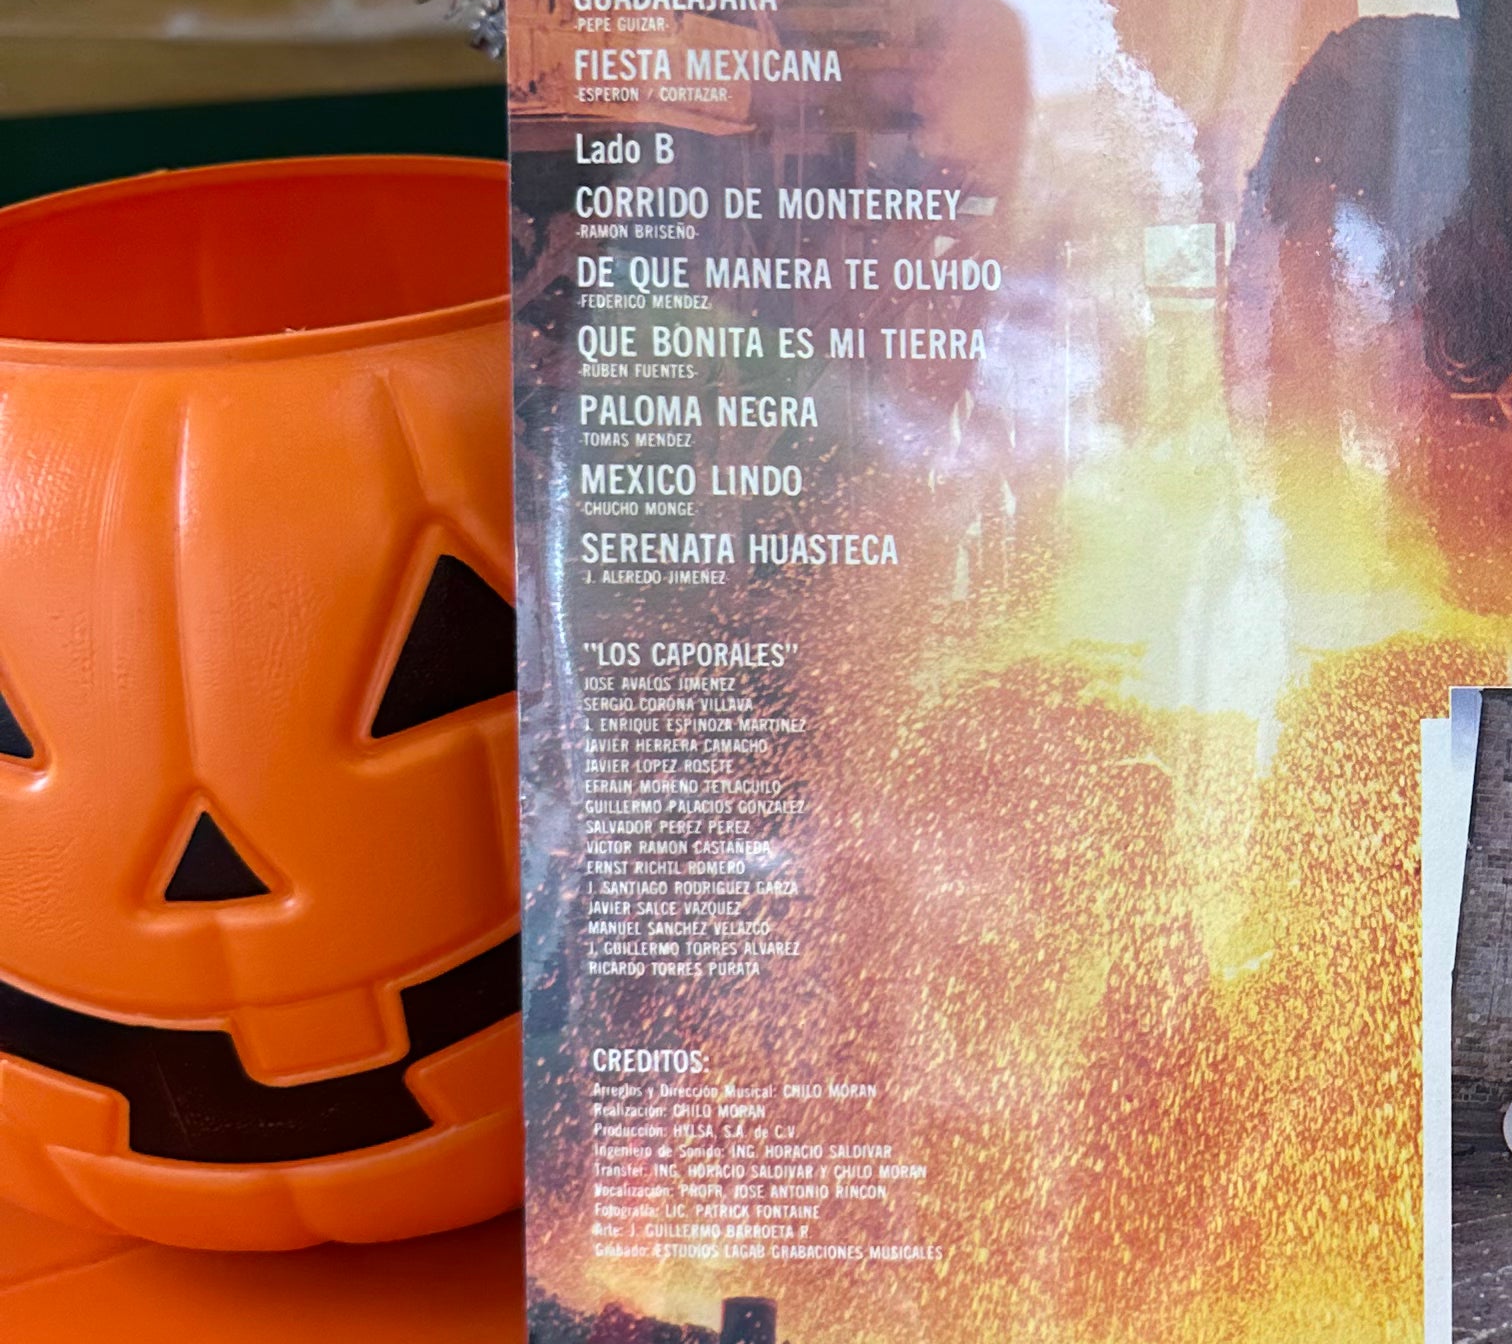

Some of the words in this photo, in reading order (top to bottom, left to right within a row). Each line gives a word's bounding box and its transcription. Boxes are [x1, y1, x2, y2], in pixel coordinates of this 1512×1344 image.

[575, 49, 670, 81] FIESTA
[687, 49, 841, 81] MEXICANA
[577, 134, 640, 164] Lado
[656, 134, 674, 164] B
[577, 187, 708, 218] CORRIDO
[726, 188, 762, 219] DE
[779, 188, 960, 221] MONTERREY
[578, 257, 614, 288] DE
[630, 257, 688, 294] QUE
[707, 258, 831, 289] MANERA
[845, 259, 879, 290] TE
[895, 259, 1000, 291] OLVIDO
[578, 326, 636, 363] QUE
[654, 327, 763, 358] BONITA
[780, 328, 814, 359] ES
[830, 328, 864, 359] MI
[882, 329, 986, 360] TIERRA
[581, 395, 701, 427] PALOMA
[718, 396, 817, 428] NEGRA
[582, 464, 696, 496] MEXICO
[713, 465, 801, 496] LINDO
[582, 533, 734, 565] SERENATA
[750, 534, 897, 566] HUASTECA
[603, 570, 662, 584] ALFREDO
[584, 677, 614, 691] JOSE
[622, 677, 671, 691] AVALOS
[679, 677, 735, 691] JIMENEZ
[584, 698, 633, 712] SERGIO
[639, 698, 694, 712] CORONA
[600, 719, 659, 734] ENRIQUE
[667, 719, 732, 732] ESPINOZA
[739, 719, 806, 733] MARTINEZ
[585, 739, 629, 752] JAVIER
[636, 739, 697, 752] HERRERA
[704, 739, 767, 753] CAMACHO
[585, 759, 629, 773] JAVIER
[636, 759, 677, 773] LOPEZ
[685, 759, 734, 773] ROSETE
[586, 780, 632, 794] EFRAIN
[640, 780, 698, 794] MORENO
[585, 800, 662, 814] GUILLERMO
[670, 800, 732, 814] PALACIOS
[738, 800, 805, 815] GONZALEZ
[586, 820, 652, 834] SALVADOR
[660, 820, 701, 834] PEREZ
[709, 820, 750, 834] PEREZ
[587, 841, 632, 854] VICTOR
[639, 841, 687, 854] RAMON
[694, 838, 771, 855] CASTAÑEDA
[587, 861, 627, 875] ERNST
[688, 861, 745, 874] ROMERO
[603, 881, 667, 895] SANTIAGO
[675, 881, 749, 895] RODRIGUEZ
[756, 881, 798, 895] GARZA
[588, 902, 630, 915] JAVIER
[637, 902, 676, 915] SALCE
[684, 902, 741, 916] VAZQUEZ
[588, 922, 641, 935] MANUEL
[648, 922, 708, 935] SANCHEZ
[714, 922, 770, 935] VELAZCO
[604, 942, 679, 955] GUILLERMO
[686, 942, 737, 955] TORRES
[744, 942, 800, 956] ALVAREZ
[590, 962, 645, 976] RICARDO
[652, 962, 702, 976] TORRES
[709, 962, 760, 976] PURATA
[593, 1048, 709, 1073] CREDITOS:
[829, 1084, 876, 1097] MORAN
[718, 1105, 765, 1118] MORAN
[754, 1125, 768, 1138] de
[765, 1145, 822, 1158] HORACIO
[830, 1145, 892, 1158] SALDIVAR
[688, 1164, 744, 1178] HORACIO
[751, 1165, 813, 1178] SALDIVAR
[879, 1165, 927, 1179] MORAN
[734, 1185, 763, 1198] JOSE
[770, 1185, 829, 1198] ANTONIO
[836, 1185, 886, 1199] RINCON
[696, 1205, 749, 1218] PATRICK
[757, 1205, 820, 1218] FONTAINE
[645, 1224, 720, 1238] GUILLERMO
[869, 1246, 943, 1260] MUSICALES
